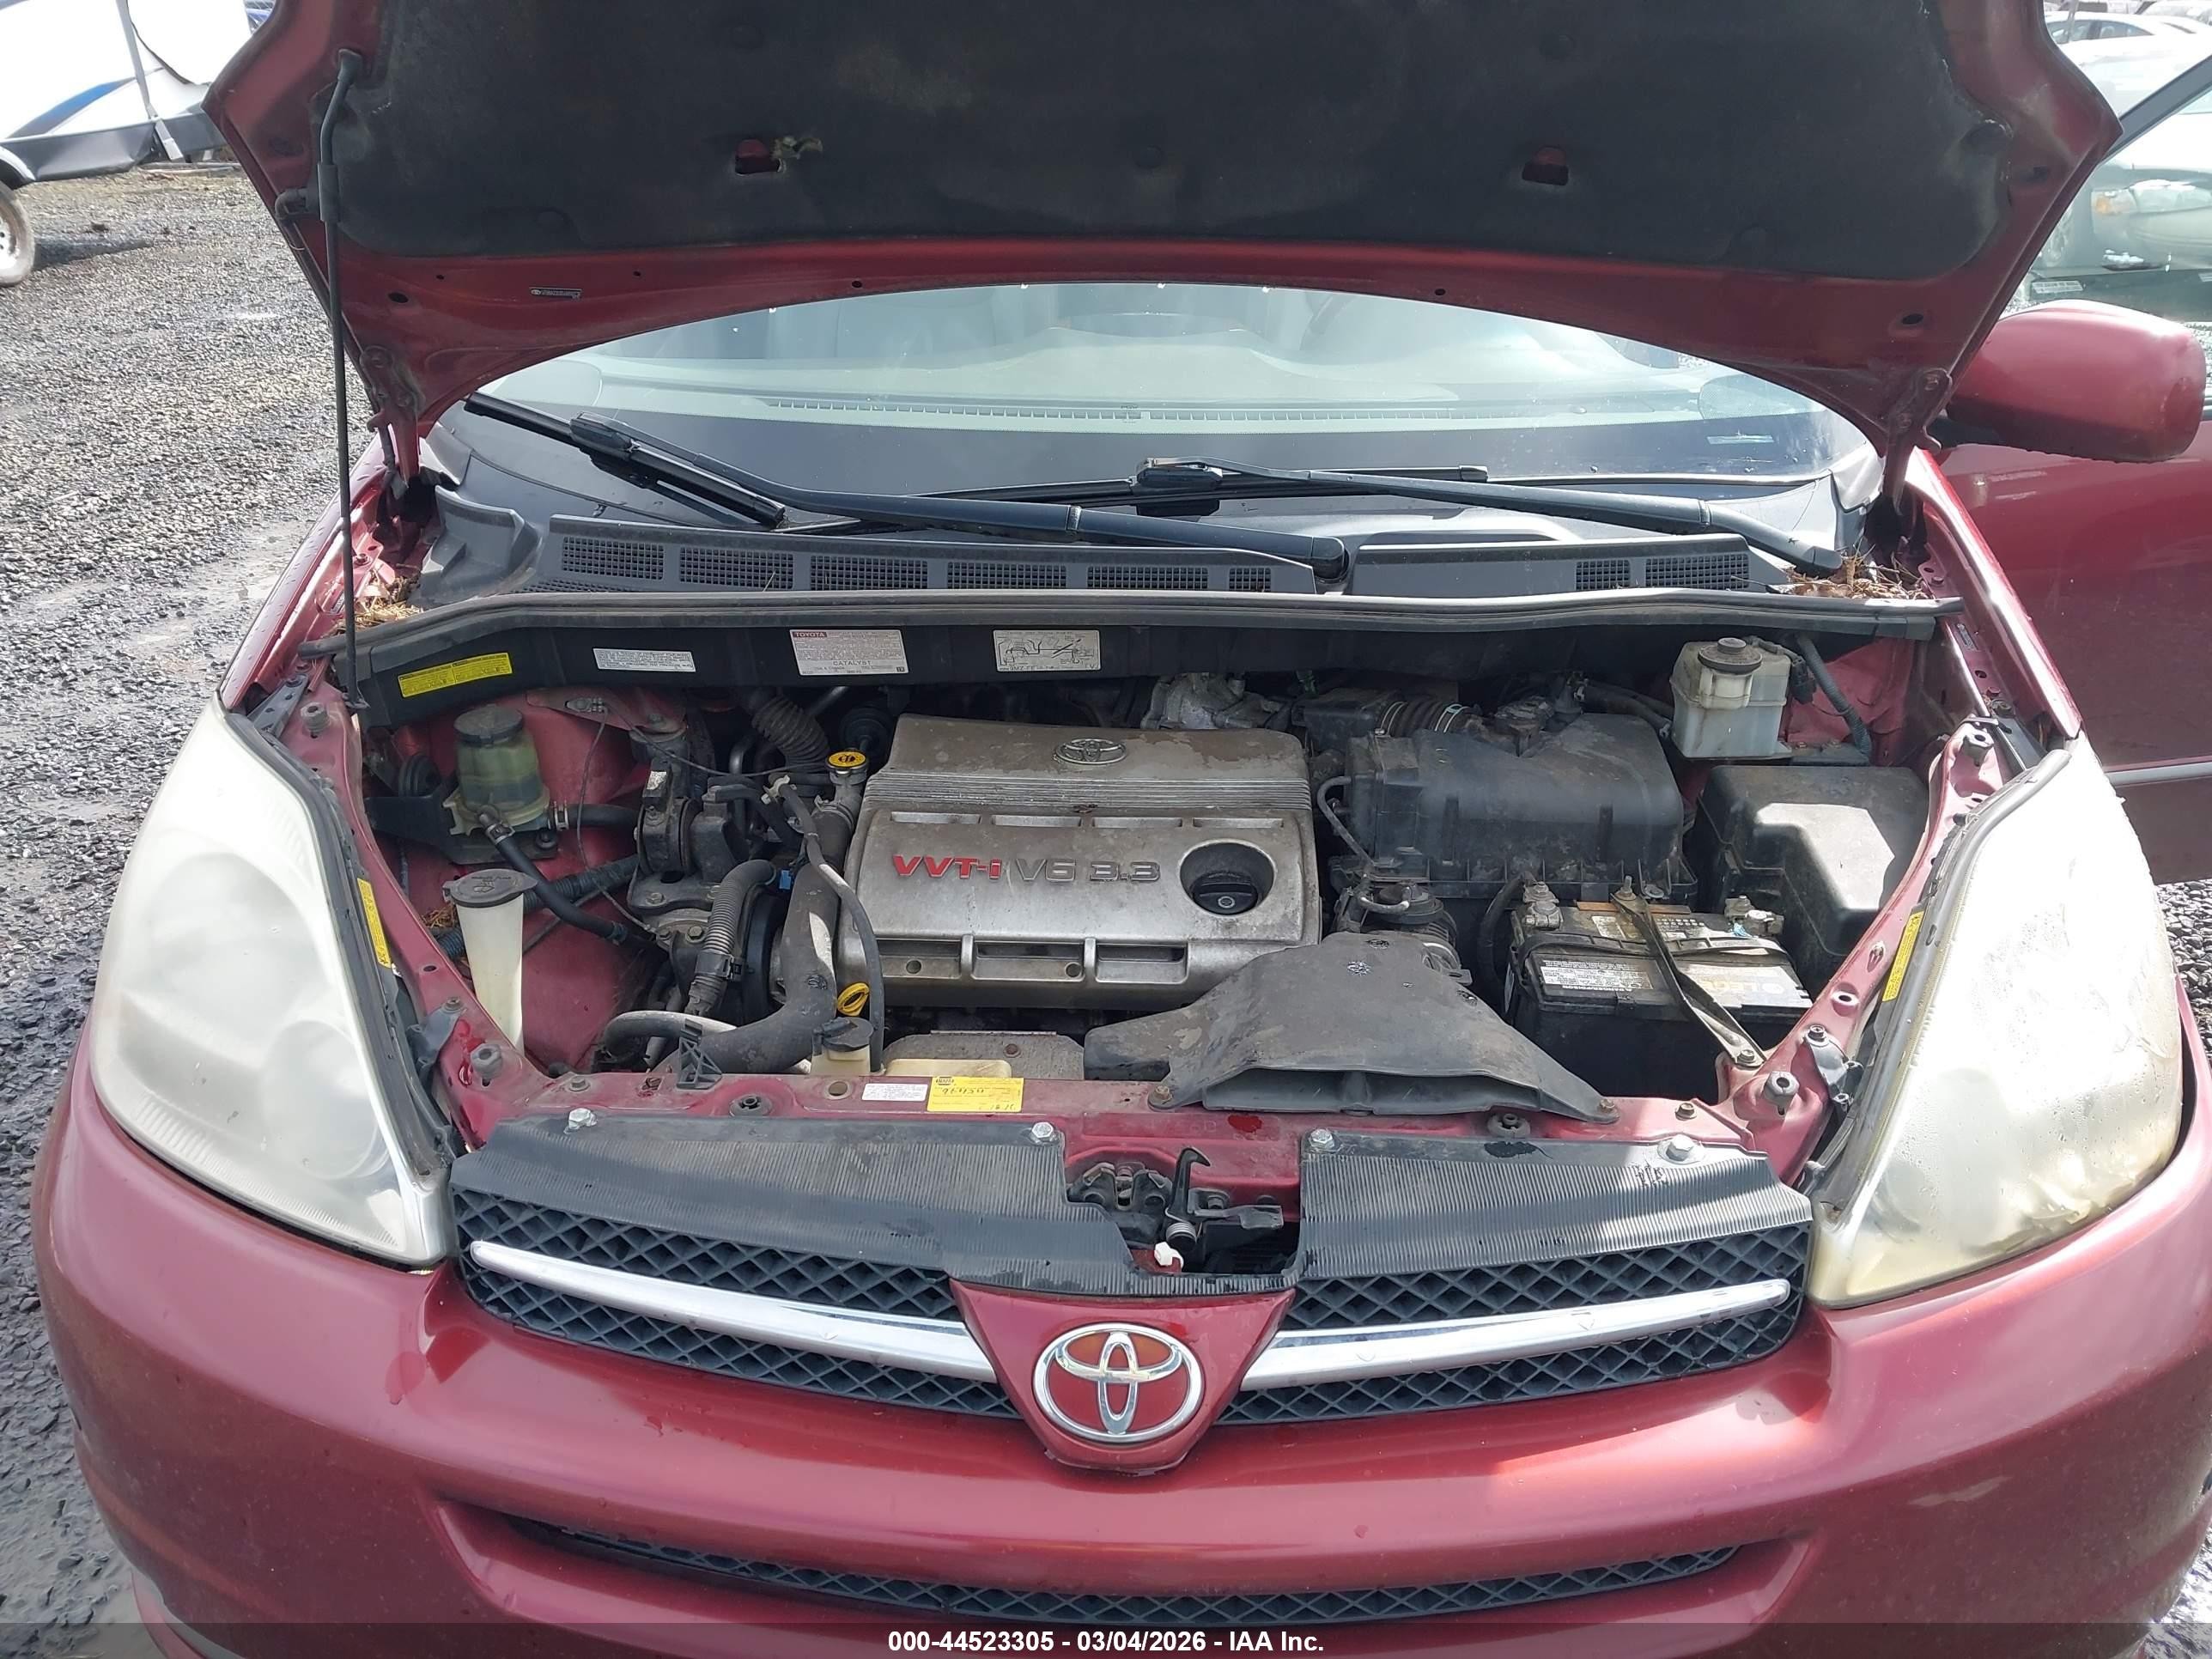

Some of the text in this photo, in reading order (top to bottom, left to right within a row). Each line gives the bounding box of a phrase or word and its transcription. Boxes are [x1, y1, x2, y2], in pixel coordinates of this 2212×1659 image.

[892, 854, 1160, 882] VVT-i V6 3.3
